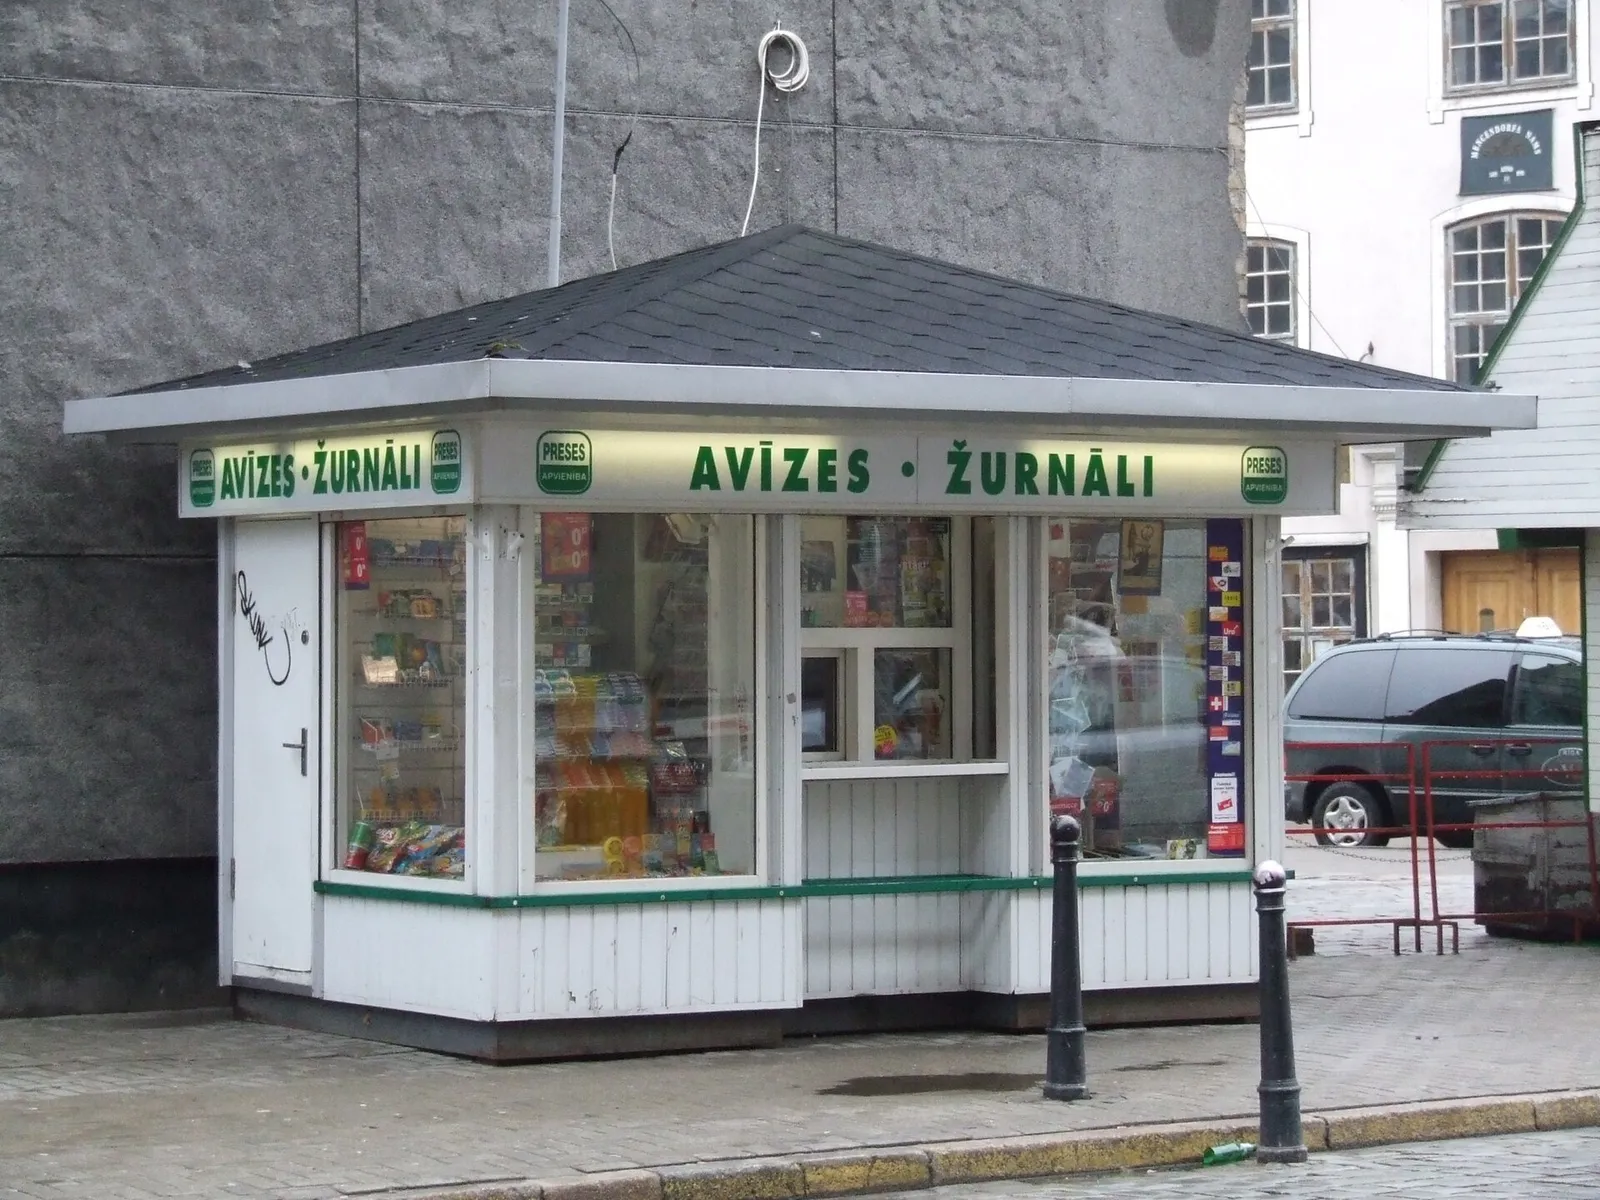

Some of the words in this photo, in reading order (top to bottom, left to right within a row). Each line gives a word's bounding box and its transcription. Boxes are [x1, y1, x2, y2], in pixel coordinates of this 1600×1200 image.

[220, 450, 295, 500] AVĪZES
[313, 439, 421, 495] ŽURNĀLI
[543, 442, 586, 461] PRESES
[689, 440, 870, 494] AVĪZES
[945, 438, 1153, 497] ŽURNĀLI
[1246, 457, 1282, 474] PRESES
